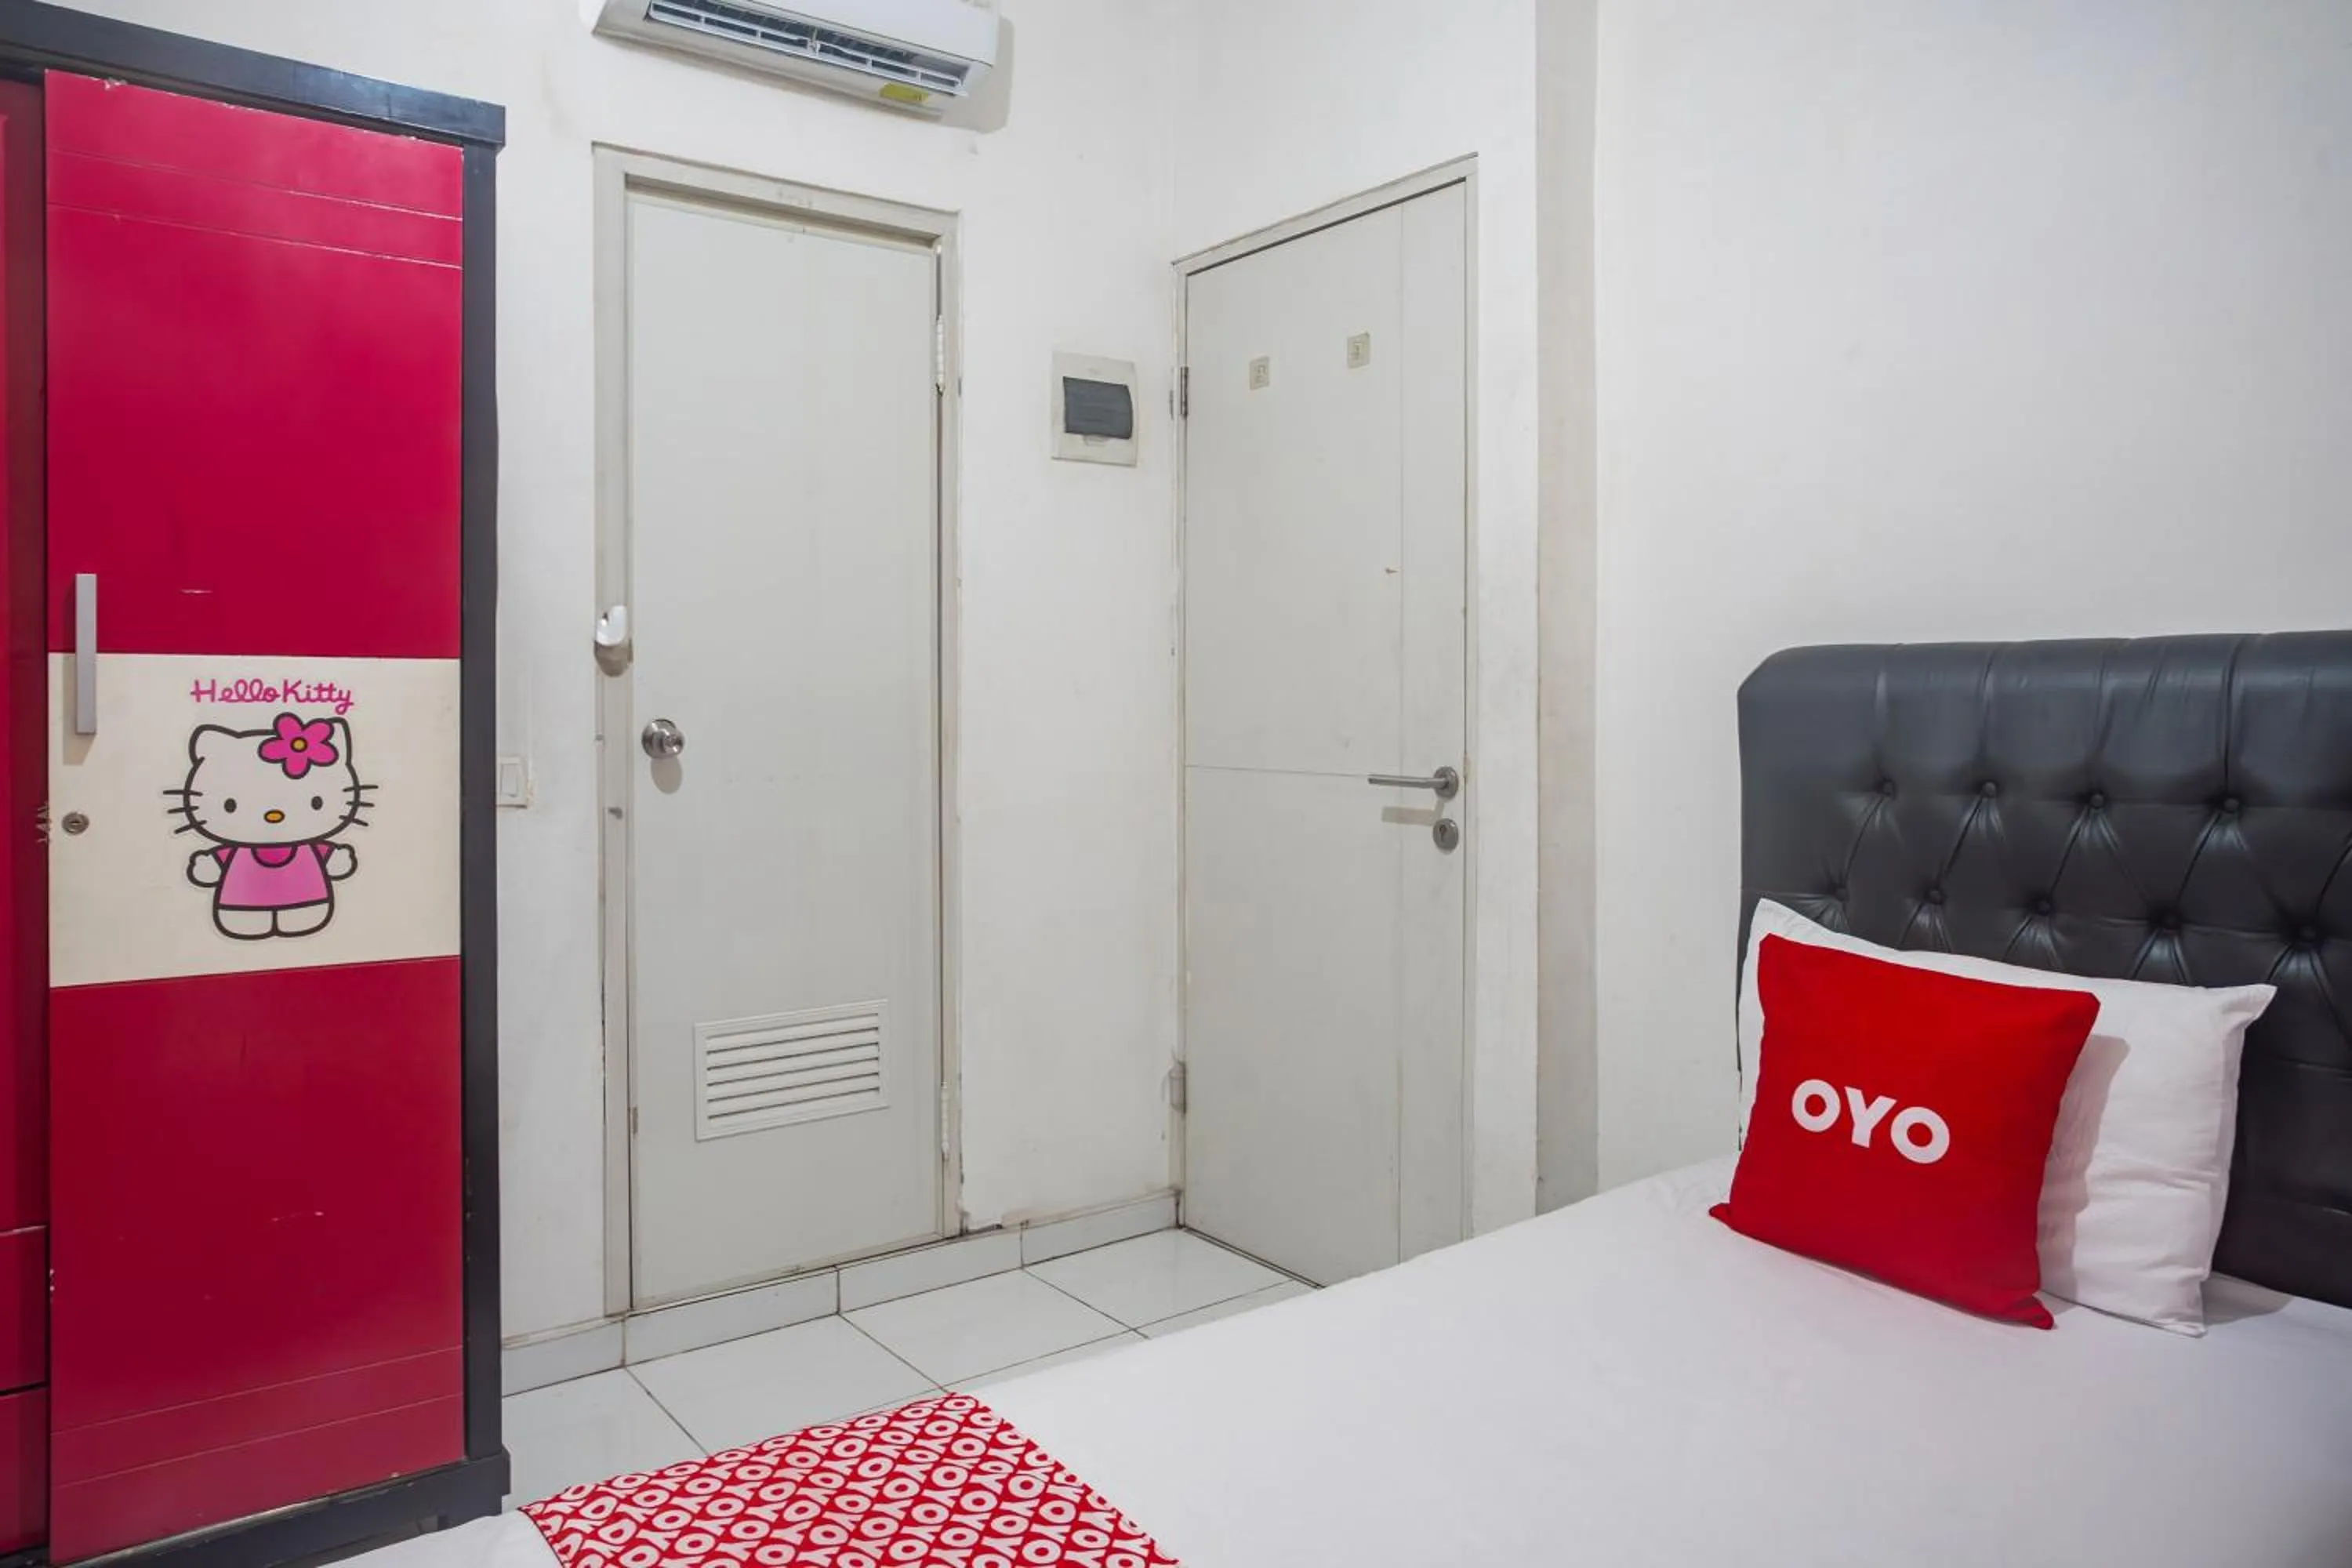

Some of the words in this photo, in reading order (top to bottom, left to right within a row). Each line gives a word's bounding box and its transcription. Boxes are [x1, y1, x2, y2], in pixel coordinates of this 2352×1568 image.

[191, 678, 280, 703] Hello
[283, 679, 354, 715] Kitty
[1791, 1079, 1950, 1164] OYO
